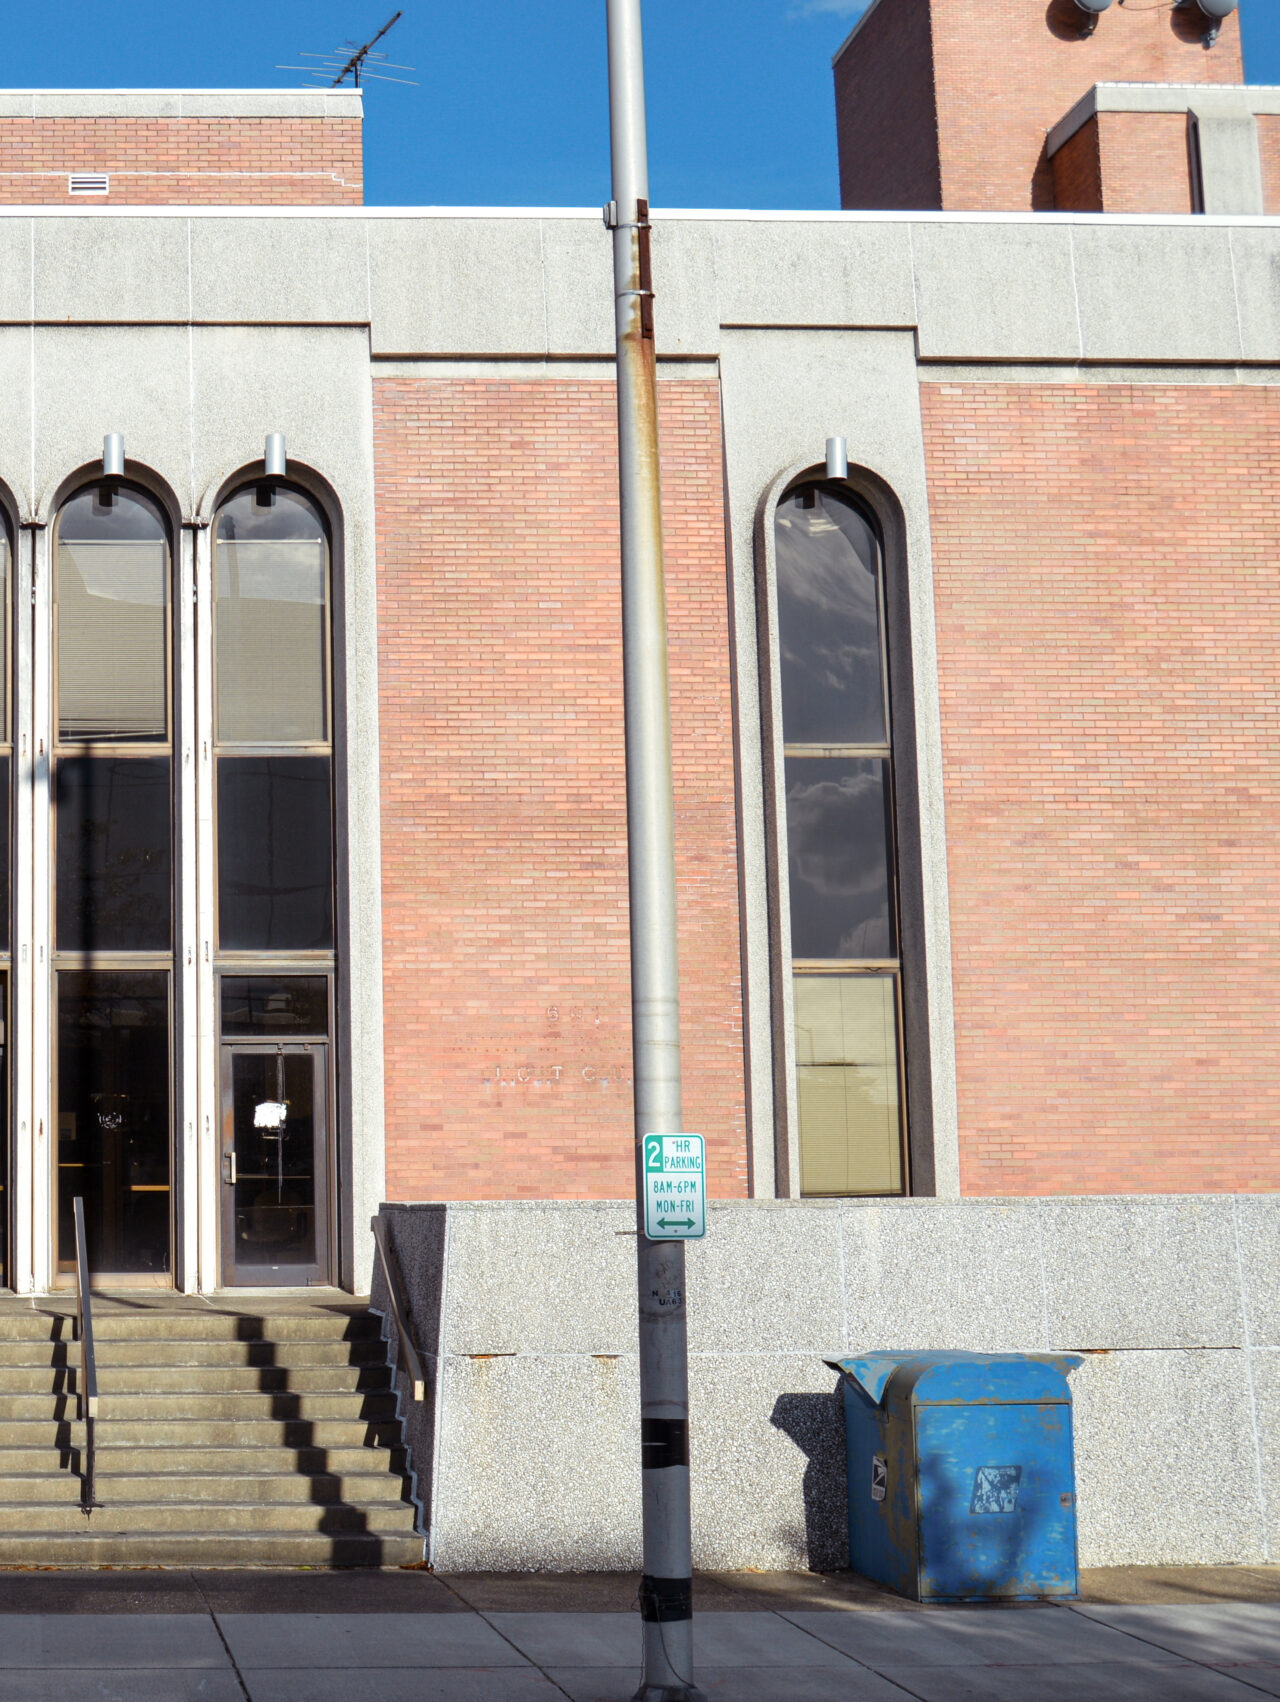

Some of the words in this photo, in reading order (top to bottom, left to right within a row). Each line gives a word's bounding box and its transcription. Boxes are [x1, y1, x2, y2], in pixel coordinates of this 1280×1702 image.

[648, 1141, 661, 1167] 2
[675, 1140, 691, 1153] HR
[664, 1156, 701, 1169] PARKING
[653, 1180, 697, 1194] 8AM-6PM
[656, 1199, 695, 1213] MON-FRI
